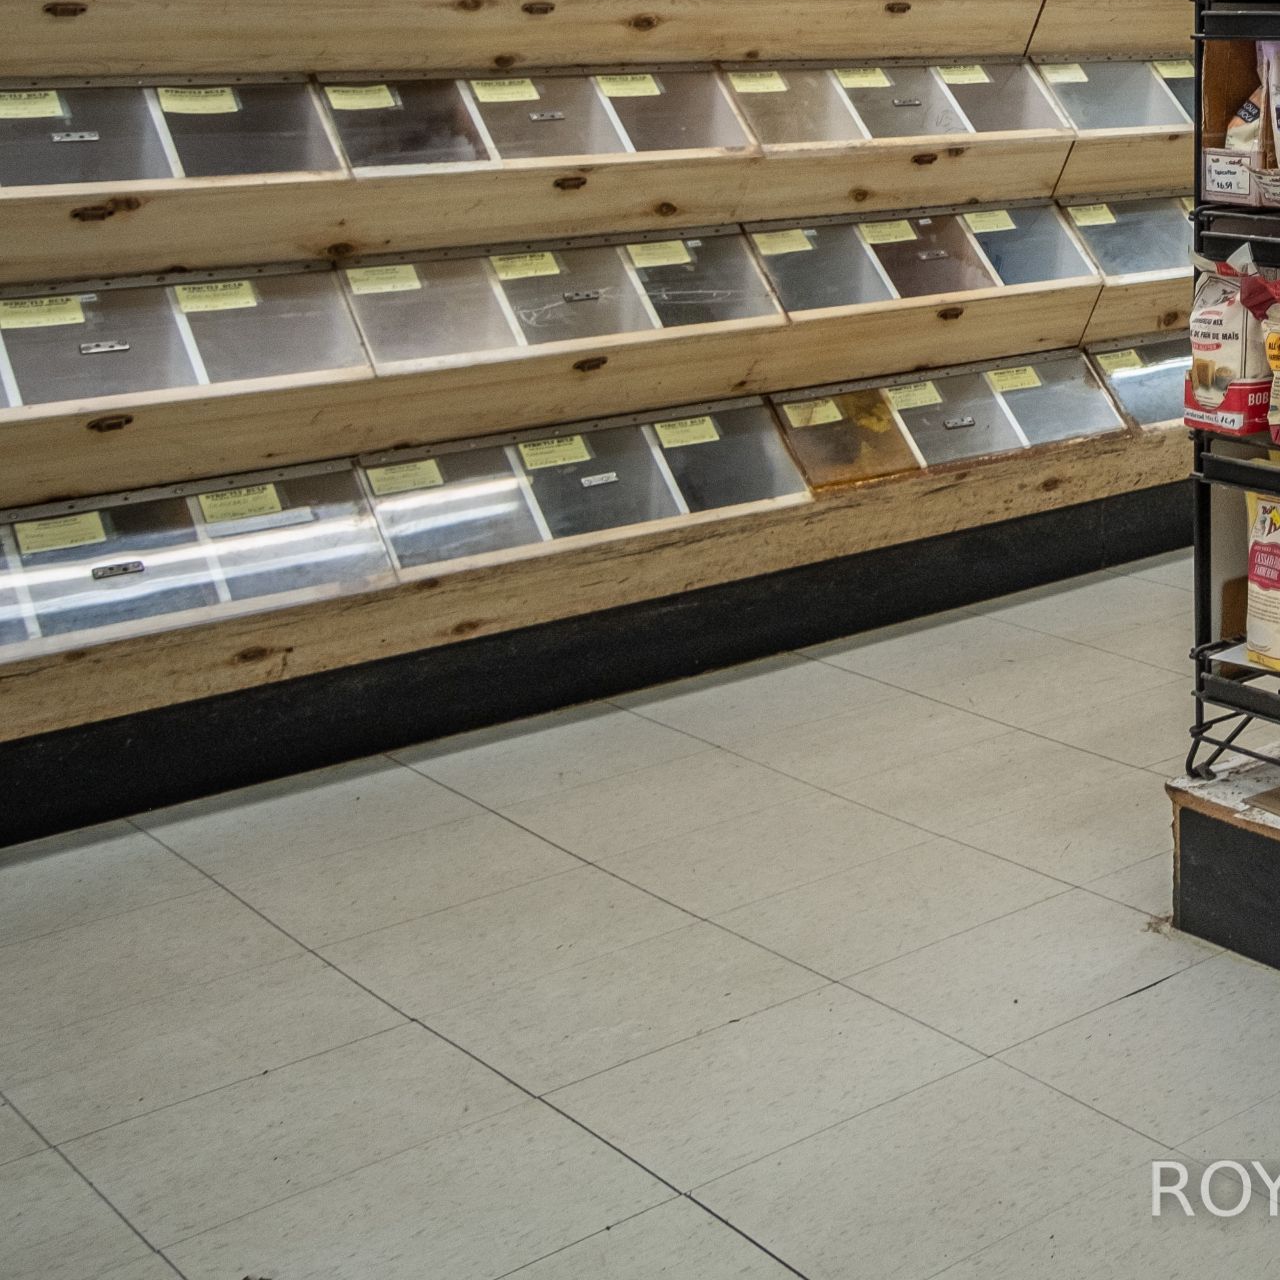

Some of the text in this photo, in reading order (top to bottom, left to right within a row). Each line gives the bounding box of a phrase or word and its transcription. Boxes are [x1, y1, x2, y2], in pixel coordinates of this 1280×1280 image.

[181, 282, 244, 293] STRICTLY BULK
[1222, 330, 1239, 341] MAÏS
[523, 436, 575, 450] STRICTLY BULK
[205, 485, 268, 501] STRICTLY BULK
